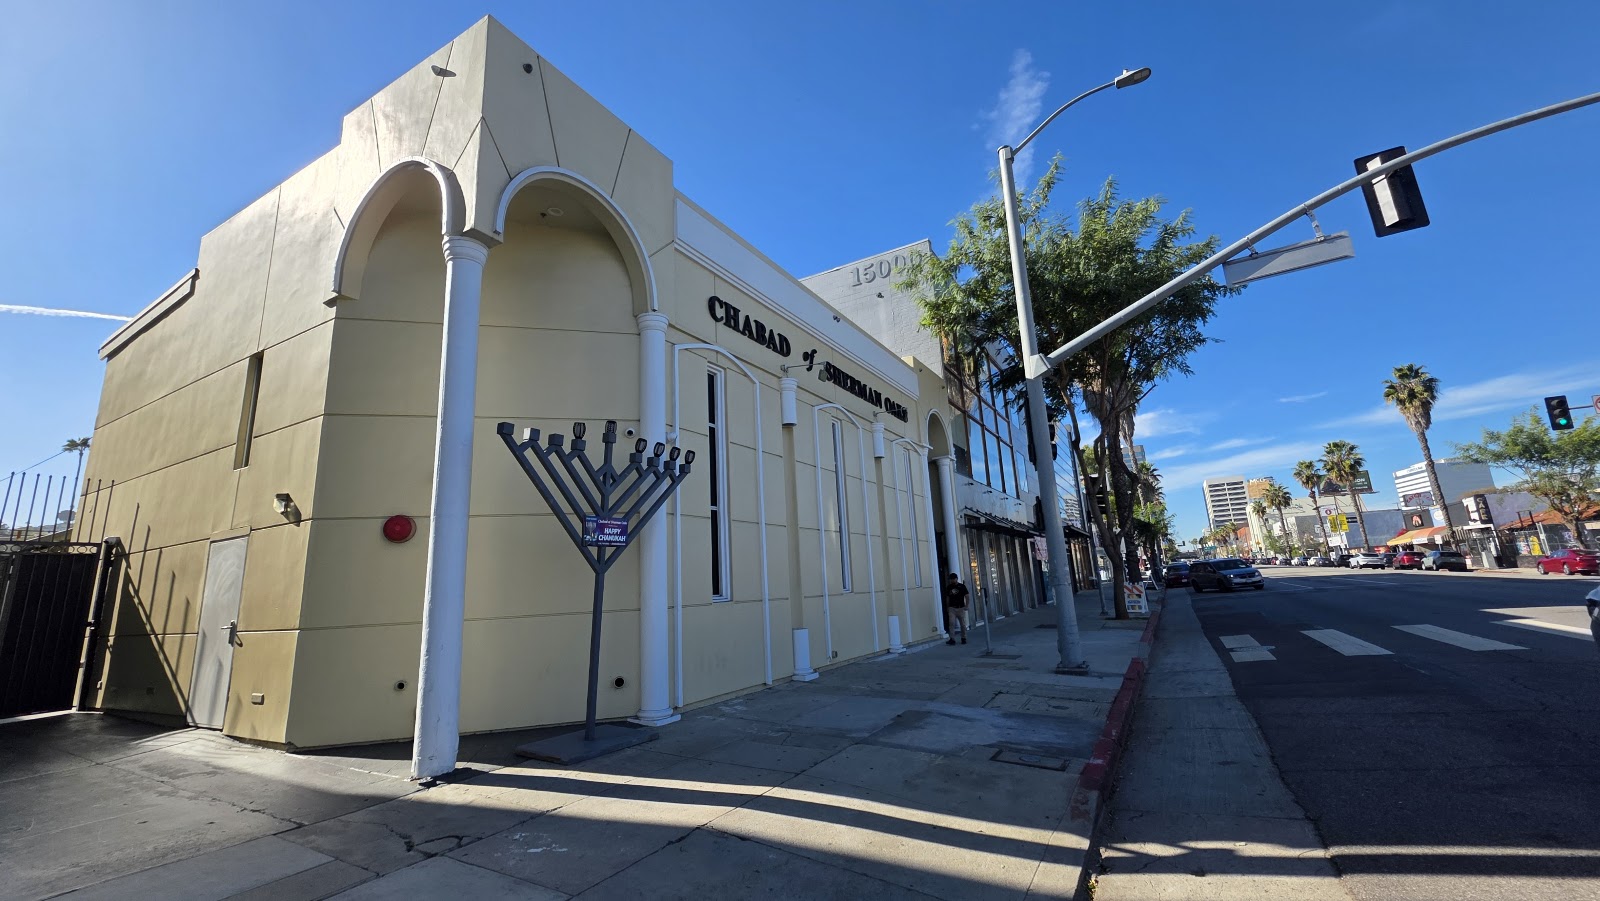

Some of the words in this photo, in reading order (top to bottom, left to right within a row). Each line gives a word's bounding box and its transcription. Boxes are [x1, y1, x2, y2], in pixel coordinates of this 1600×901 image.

[708, 295, 791, 357] CHABAD
[802, 349, 818, 372] of
[824, 361, 882, 409] SHERMAN
[884, 397, 909, 423] OAKS
